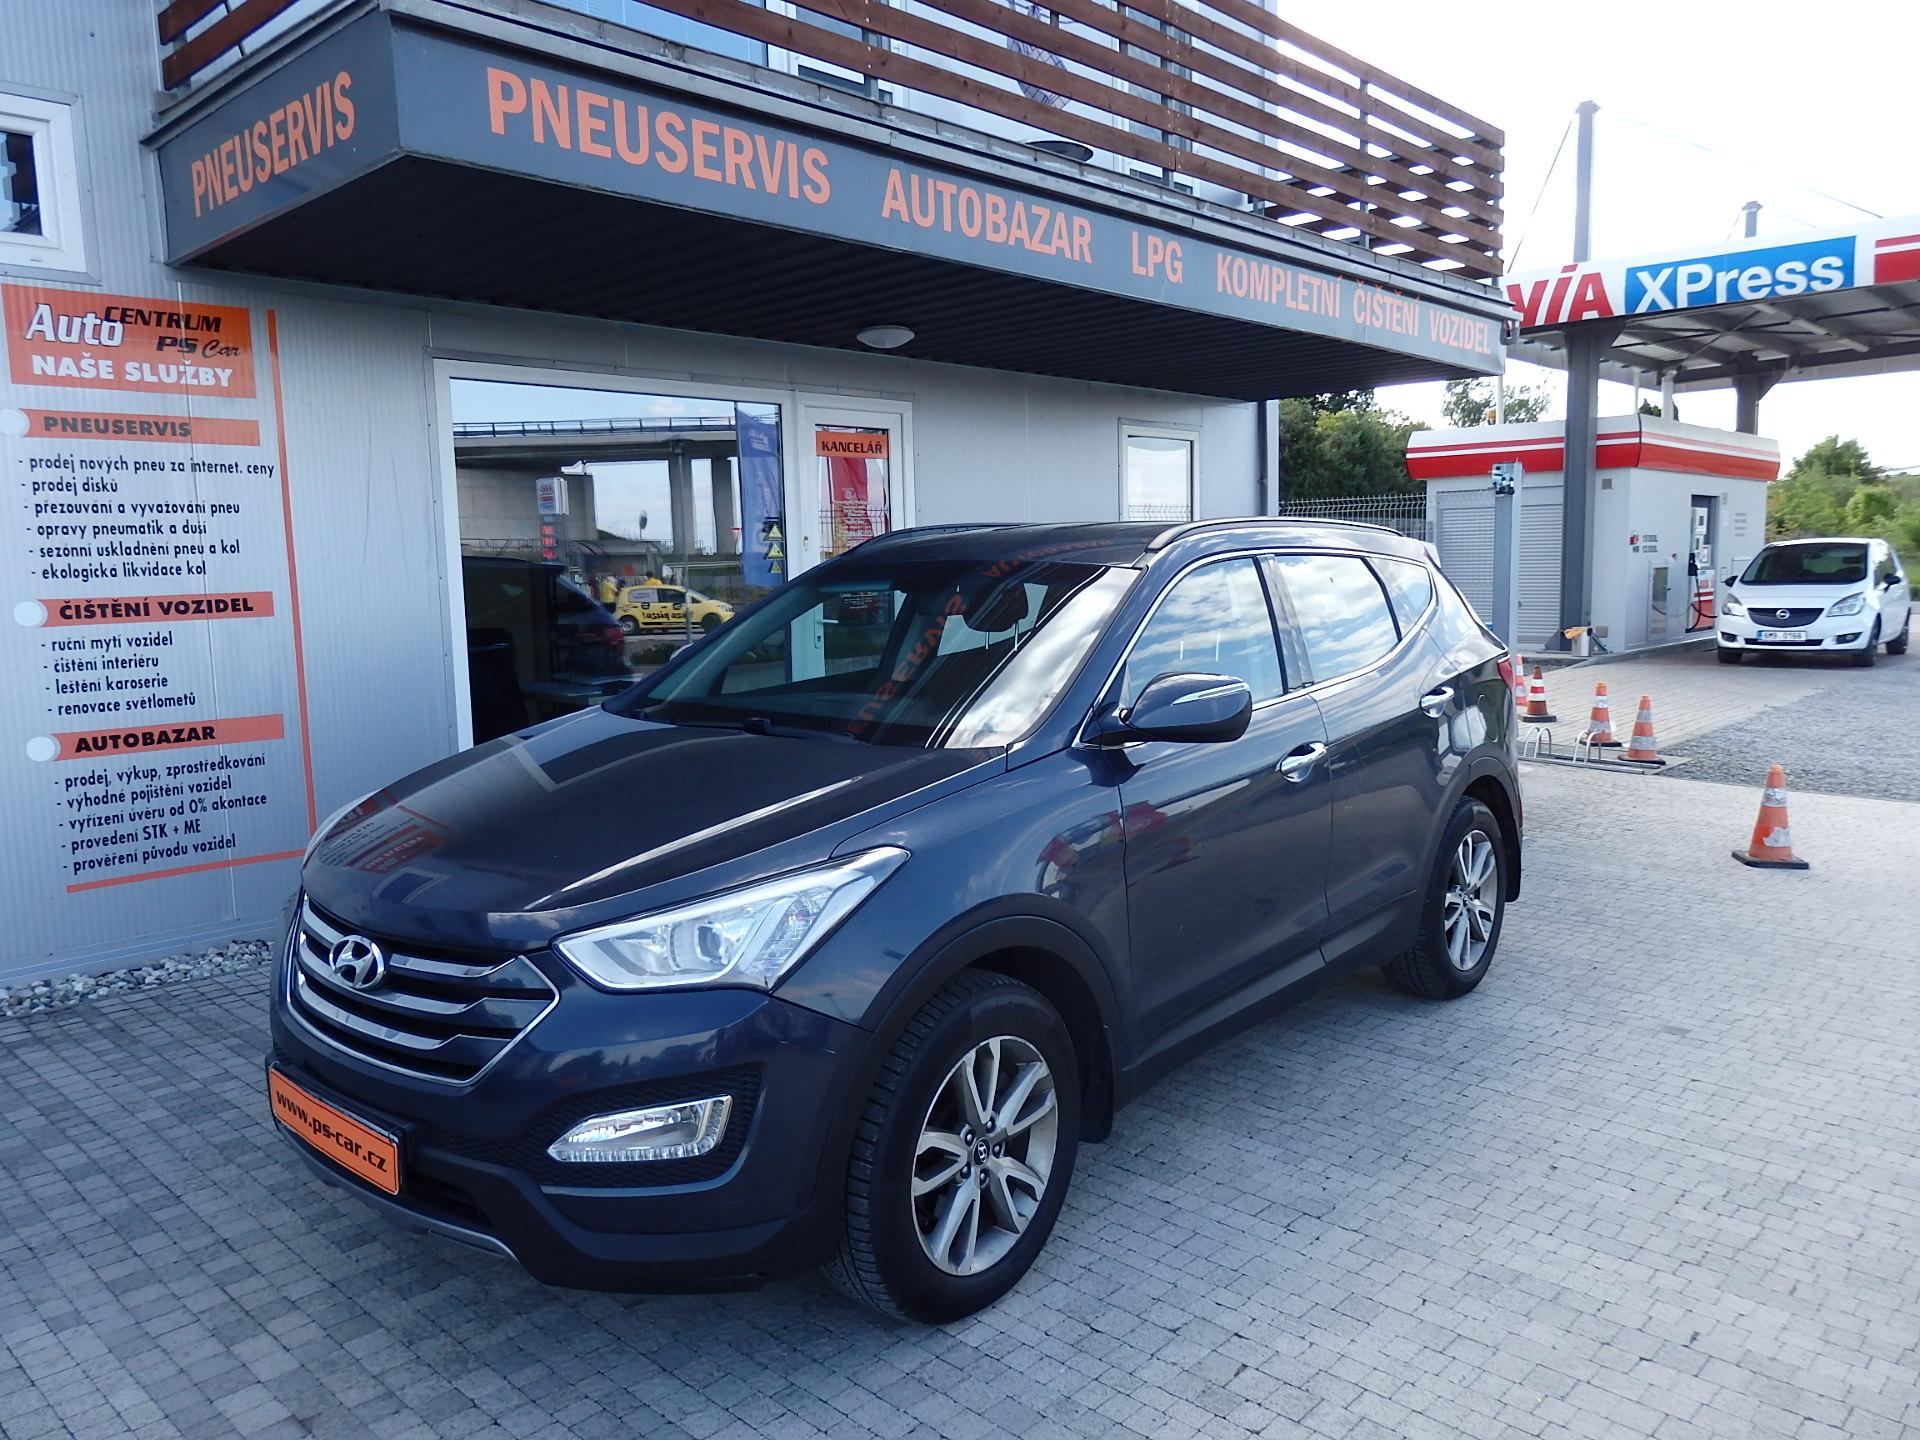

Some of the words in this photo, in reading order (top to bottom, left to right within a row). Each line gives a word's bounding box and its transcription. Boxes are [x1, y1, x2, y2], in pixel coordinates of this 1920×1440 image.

[191, 71, 356, 218] PNEUSERVIS
[486, 66, 832, 205] PNEUSERVIS
[881, 168, 1094, 264] AUTOBAZAR
[1131, 230, 1184, 284] LPG
[1216, 252, 1341, 318] KOMPLETNÍ
[1352, 278, 1420, 337] ČIŠTĚNÍ
[1429, 309, 1491, 355] VOZIDEL
[1634, 255, 1845, 313] XPress
[24, 303, 124, 347] Auto
[103, 306, 222, 333] CENTRUM
[156, 335, 198, 353] PS
[201, 339, 240, 359] Car
[32, 352, 114, 380] NAŠE
[124, 360, 233, 387] SLUŽBY
[43, 416, 192, 437] PNEUSERVIS
[821, 440, 883, 454] KANCELÁŘ
[30, 453, 75, 473] prodej
[80, 456, 128, 474] nových
[134, 461, 165, 474] pneu
[170, 462, 185, 472] za
[190, 457, 243, 474] internet.
[247, 463, 275, 478] ceny
[32, 476, 77, 496] prodej
[35, 500, 112, 518] přezouvání
[117, 504, 126, 514] a
[131, 500, 206, 518] vyvažování
[210, 503, 240, 517] pneu
[37, 525, 87, 540] opravy
[92, 519, 164, 540] pneumatik
[169, 525, 177, 534] a
[182, 519, 207, 534] duší
[40, 542, 92, 558] sezónní
[97, 541, 169, 557] uskladnění
[174, 544, 204, 558] pneu
[209, 544, 217, 554] a
[221, 539, 240, 554] kol
[42, 562, 118, 582] ekologická
[123, 561, 182, 577] likvidace
[187, 560, 206, 577] kol
[59, 597, 150, 620] ČIŠTĚNÍ
[158, 598, 254, 616] VOZIDEL
[52, 636, 86, 651] ruční
[127, 631, 173, 648] vozidel
[54, 657, 98, 673] čištění
[102, 653, 159, 670] interiéru
[56, 677, 101, 694] leštění
[106, 672, 168, 690] karoserie
[58, 700, 121, 716] renovace
[126, 692, 196, 711] světlometů
[75, 725, 216, 753] AUTOBAZAR
[65, 768, 112, 792] prodej,
[117, 765, 161, 785] výkup,
[166, 753, 266, 779] zprostředkování
[67, 789, 126, 812] výhodné
[131, 782, 184, 805] pojištění
[188, 775, 232, 794] vozidel
[69, 810, 124, 833] vyřízení
[129, 807, 165, 822] úvěru
[170, 801, 185, 817] od
[189, 797, 208, 813] 0%
[212, 794, 267, 811] akontace
[71, 829, 139, 855] provedení
[143, 823, 168, 841] STK
[184, 819, 201, 835] ME
[73, 848, 138, 875] prověření
[142, 841, 188, 865] původu
[192, 833, 236, 853] vozidel
[276, 1090, 388, 1173] www.ps-car.cz
